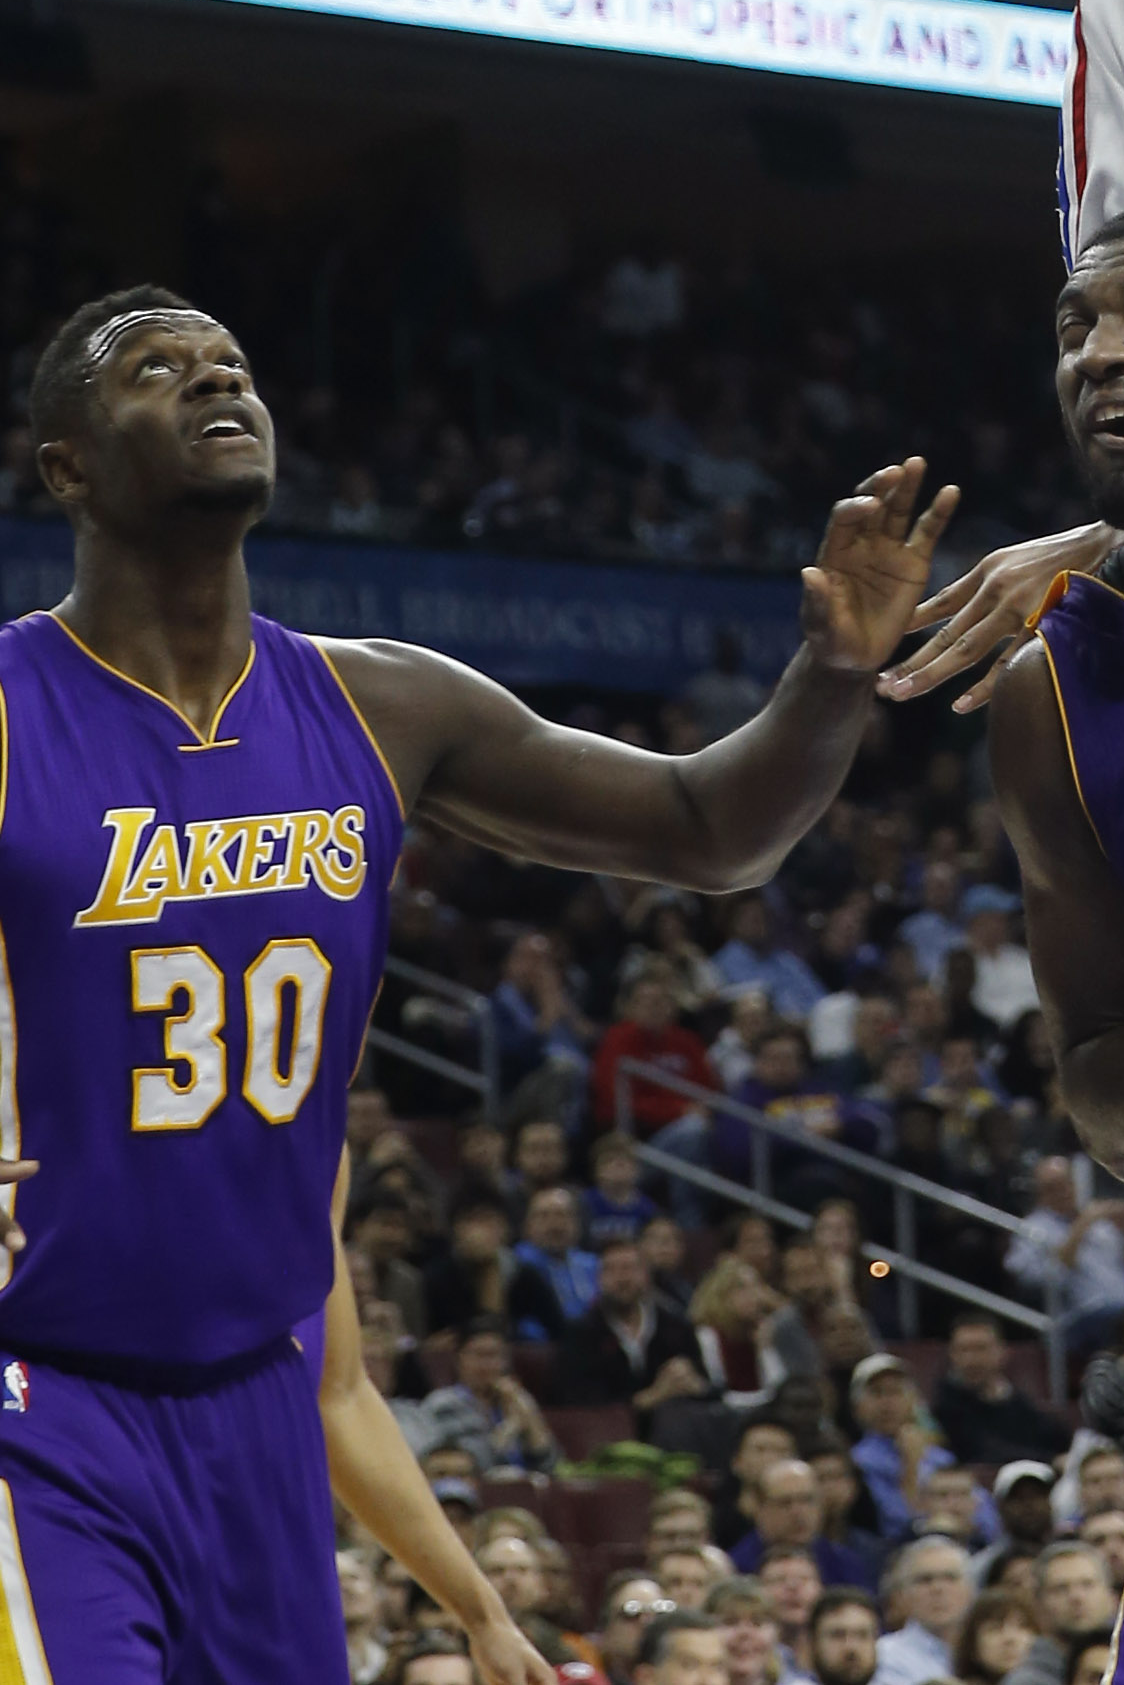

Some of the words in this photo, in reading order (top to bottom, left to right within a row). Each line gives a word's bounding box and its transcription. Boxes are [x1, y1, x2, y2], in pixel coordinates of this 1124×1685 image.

[880, 16, 984, 72] AND
[72, 804, 368, 930] LAKERS
[130, 937, 333, 1133] 30
